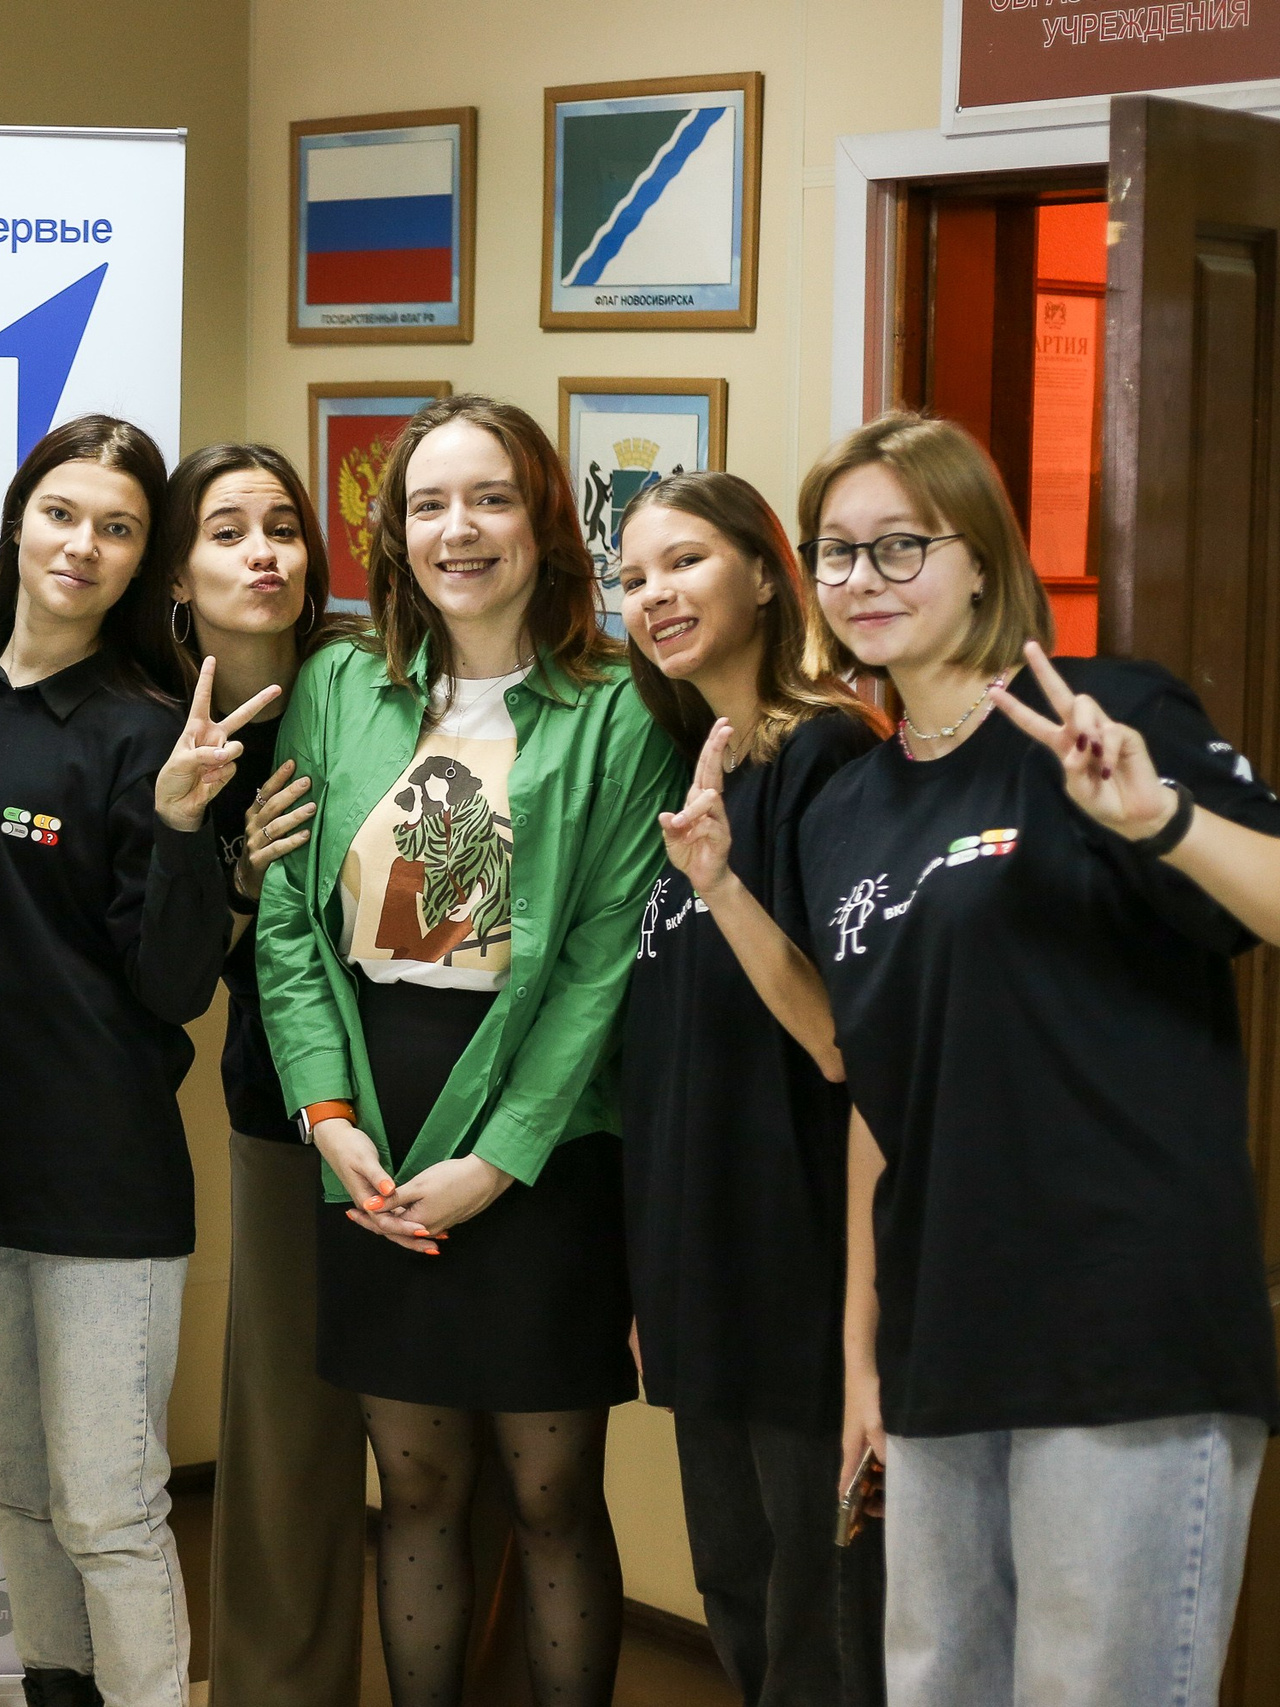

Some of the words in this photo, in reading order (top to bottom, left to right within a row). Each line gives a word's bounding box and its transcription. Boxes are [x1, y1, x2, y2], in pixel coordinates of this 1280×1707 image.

[1043, 0, 1250, 47] УЧРЕЖДЕНИЯ
[595, 295, 619, 306] ФЛАГ
[620, 294, 695, 306] НОВОСИБИРСКА
[1036, 335, 1087, 355] АРТИЯ
